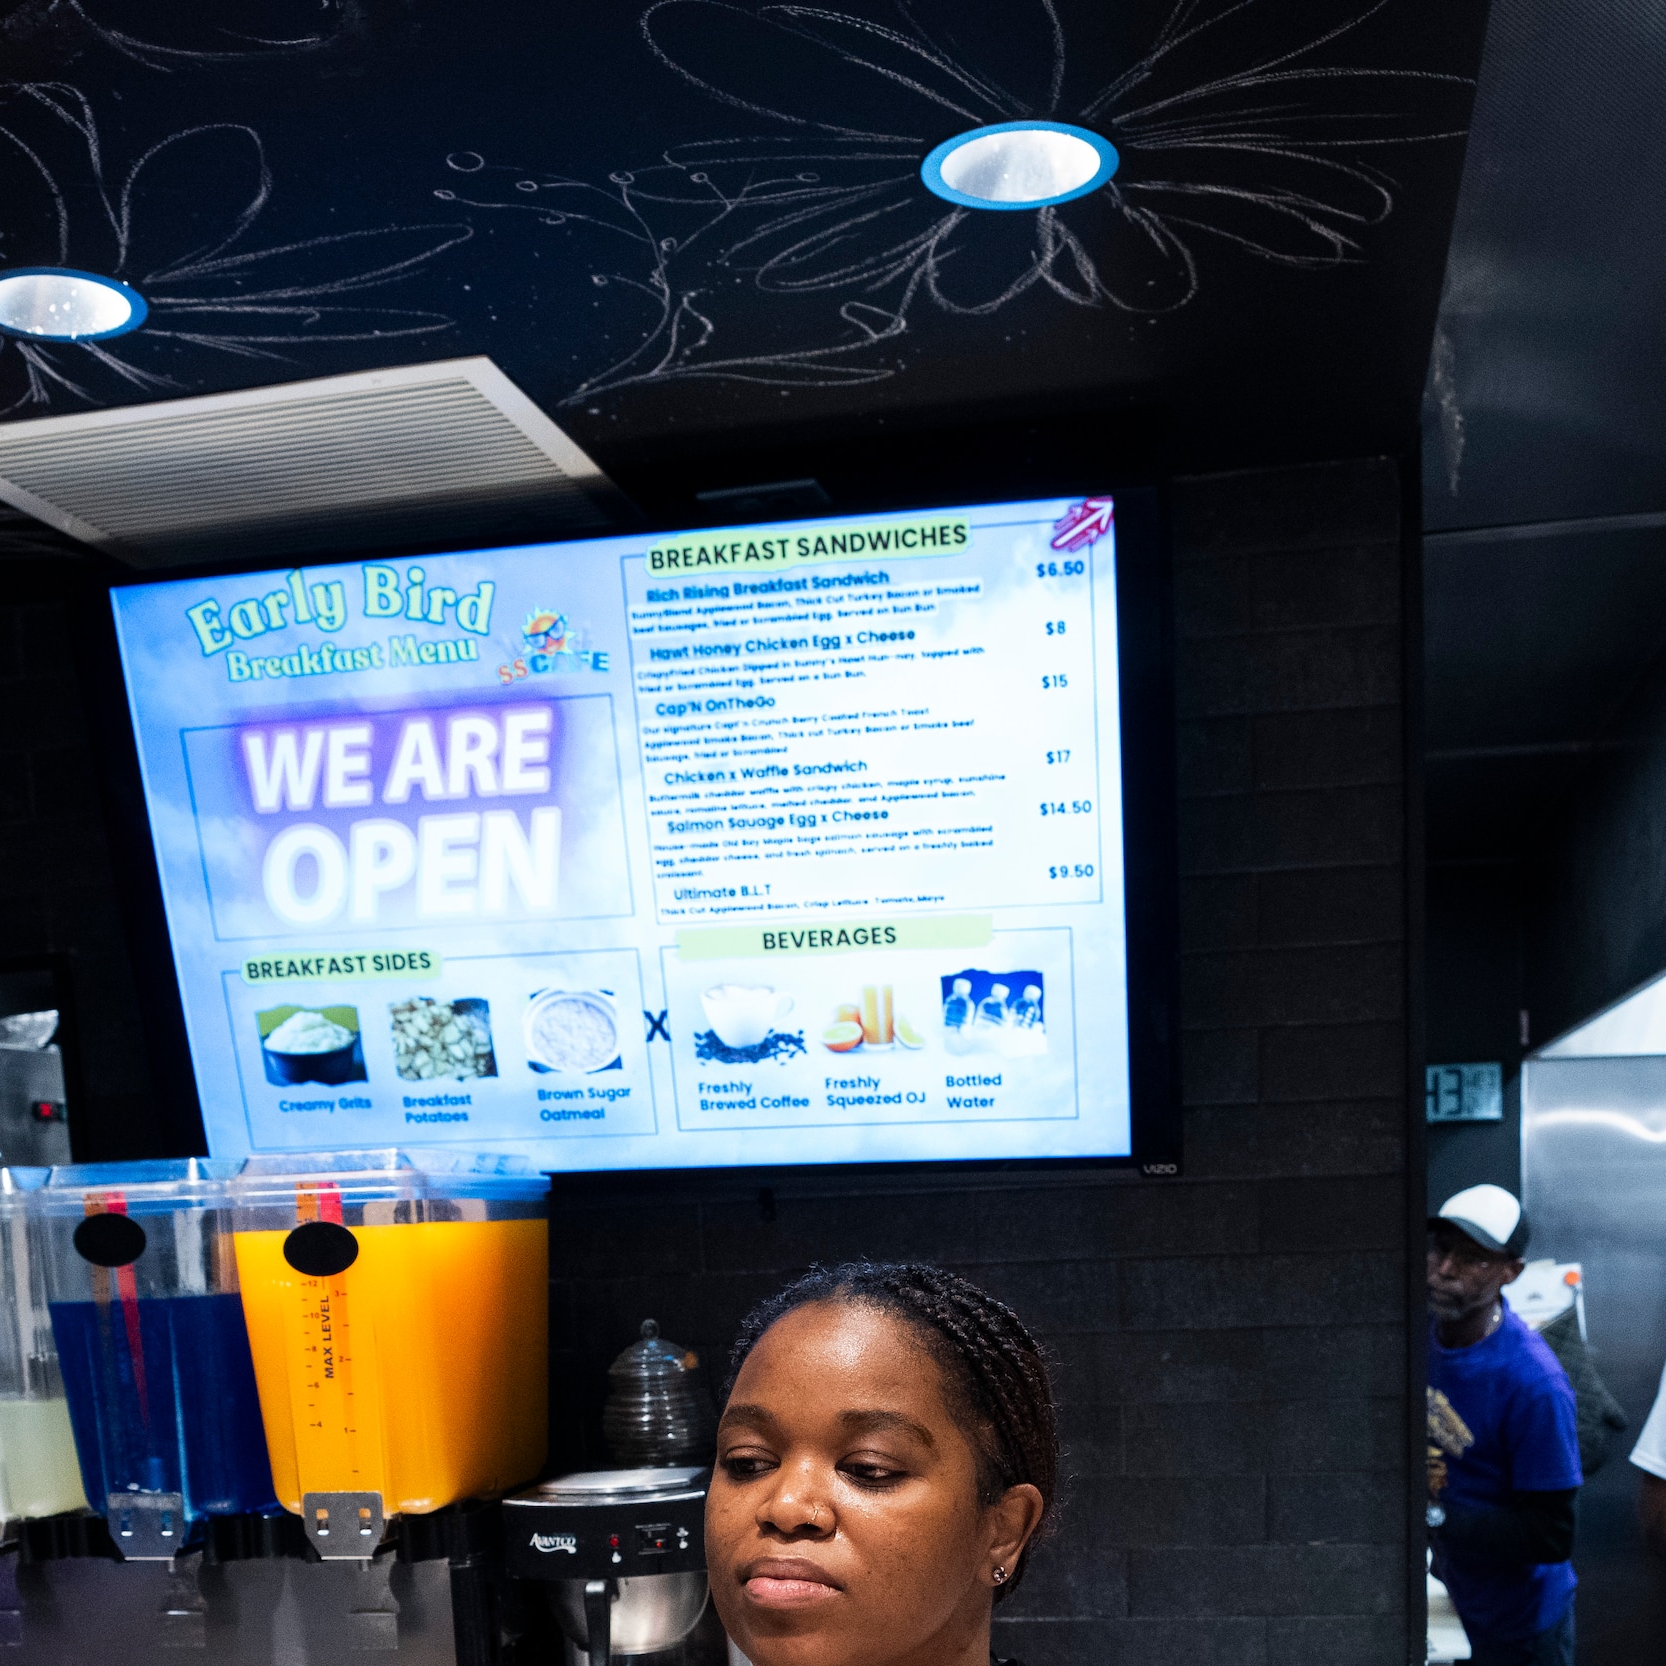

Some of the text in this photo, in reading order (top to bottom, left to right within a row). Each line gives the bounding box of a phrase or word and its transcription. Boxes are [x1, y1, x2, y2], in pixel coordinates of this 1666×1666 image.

[650, 524, 967, 570] BREAKFAST SANDWICHES
[1036, 560, 1084, 578] $6.50
[646, 570, 890, 603] Rich Rising Breakfast Sandwich
[186, 564, 496, 657] Early Bird
[1045, 620, 1066, 636] $8
[693, 641, 741, 658] Honey
[745, 634, 808, 652] Chicken
[813, 633, 840, 650] Egg
[844, 635, 852, 644] x
[856, 630, 916, 645] Cheese
[226, 634, 479, 682] Breakfast Menu
[1042, 673, 1068, 690] $15
[655, 696, 776, 717] Cap'N OnTheGo
[241, 707, 552, 814] WE ARE
[1046, 749, 1071, 765] $17
[664, 760, 868, 786] Chicken x Waffle Sandwich
[1040, 800, 1092, 816] $14.50
[667, 818, 724, 835] Salmon
[789, 813, 817, 828] Egg
[821, 814, 828, 822] x
[832, 809, 889, 822] Cheese
[262, 806, 562, 927] OPEN
[1049, 864, 1094, 879] $9.50
[674, 886, 736, 900] Ultimate
[762, 927, 896, 950] BEVERAGES
[246, 952, 432, 980] BREAKFAST SIDES
[698, 1080, 753, 1096] Freshly
[825, 1076, 880, 1093] Freshly
[945, 1073, 1002, 1088] Bottled
[402, 1093, 472, 1109] Breakfast
[537, 1086, 631, 1102] Brown Sugar
[827, 1091, 926, 1108] Squeezed OJ
[946, 1095, 995, 1109] Water
[278, 1096, 372, 1114] Creamy Grits
[699, 1095, 810, 1111] Brewed Coffee
[405, 1109, 469, 1124] Potatoes
[540, 1107, 606, 1122] Oatmeal
[1143, 1164, 1177, 1174] VIZIO
[320, 1295, 334, 1379] MAX LEVEL
[529, 1533, 577, 1551] AVANTCO
